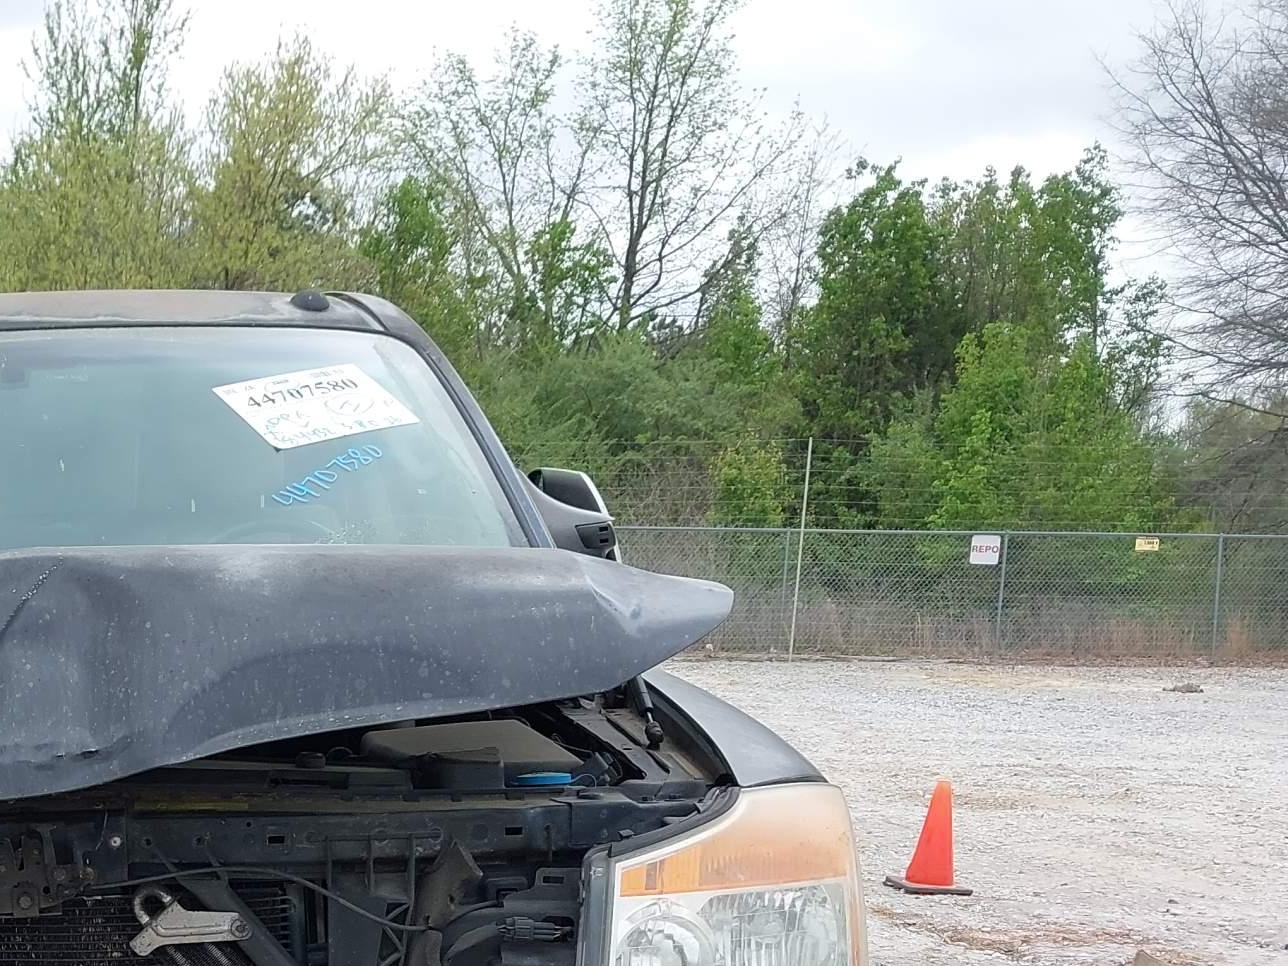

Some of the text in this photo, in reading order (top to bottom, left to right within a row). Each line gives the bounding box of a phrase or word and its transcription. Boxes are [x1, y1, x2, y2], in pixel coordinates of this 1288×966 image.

[247, 378, 358, 408] 44707580
[272, 445, 383, 505] 44707580
[972, 544, 999, 554] REPO
